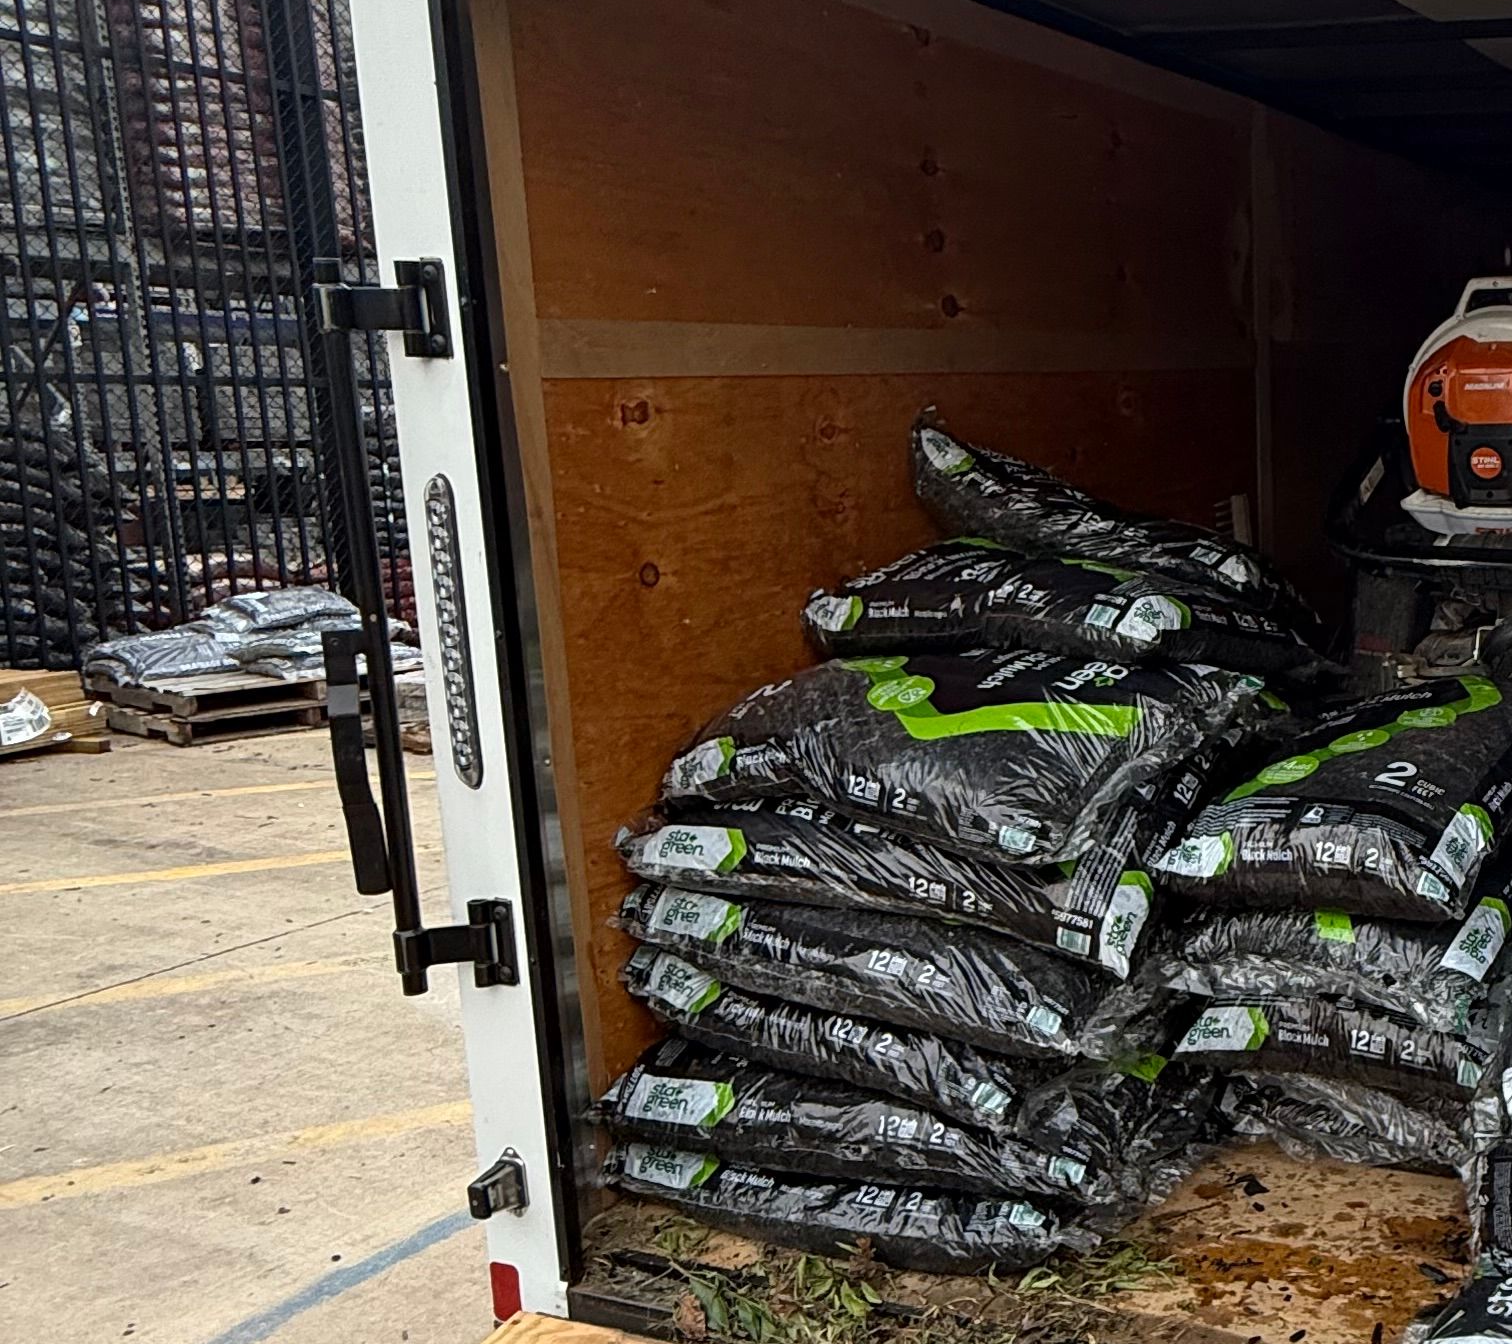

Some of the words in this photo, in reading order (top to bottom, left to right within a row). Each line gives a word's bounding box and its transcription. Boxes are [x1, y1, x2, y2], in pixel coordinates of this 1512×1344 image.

[1471, 456, 1500, 465] STIHL
[1374, 761, 1417, 787] 2
[848, 775, 866, 797] 12
[891, 788, 906, 809] 2
[1411, 785, 1435, 798] FEET
[1416, 779, 1446, 796] CUBIC
[665, 829, 690, 842] sta
[660, 840, 704, 858] green
[1241, 849, 1265, 862] Black
[1266, 850, 1293, 863] Mulch
[1315, 841, 1335, 862] 12
[1364, 848, 1380, 868] 2
[754, 851, 781, 866] Black
[781, 854, 811, 869] Mulch
[908, 876, 929, 898] 12
[962, 890, 977, 910] 2
[1115, 911, 1138, 956] green
[1458, 931, 1478, 955] sta
[1469, 926, 1497, 965] green
[664, 961, 689, 981] sta
[867, 949, 888, 972] 12
[917, 963, 935, 984] 2
[832, 1017, 852, 1036] 12
[875, 1033, 893, 1054] 2
[1187, 1026, 1232, 1045] green
[1278, 1029, 1302, 1044] Black
[1302, 1031, 1330, 1048] Mulch
[1350, 1029, 1370, 1052] 12
[1402, 1039, 1416, 1061] 2
[650, 1082, 678, 1097] sta
[642, 1092, 689, 1112] green
[766, 1108, 792, 1124] Mulch
[877, 1115, 900, 1136] 12
[929, 1122, 946, 1144] 2
[638, 1155, 684, 1175] green
[747, 1173, 775, 1189] Mulch
[855, 1185, 878, 1204] 12
[905, 1191, 923, 1210] 2
